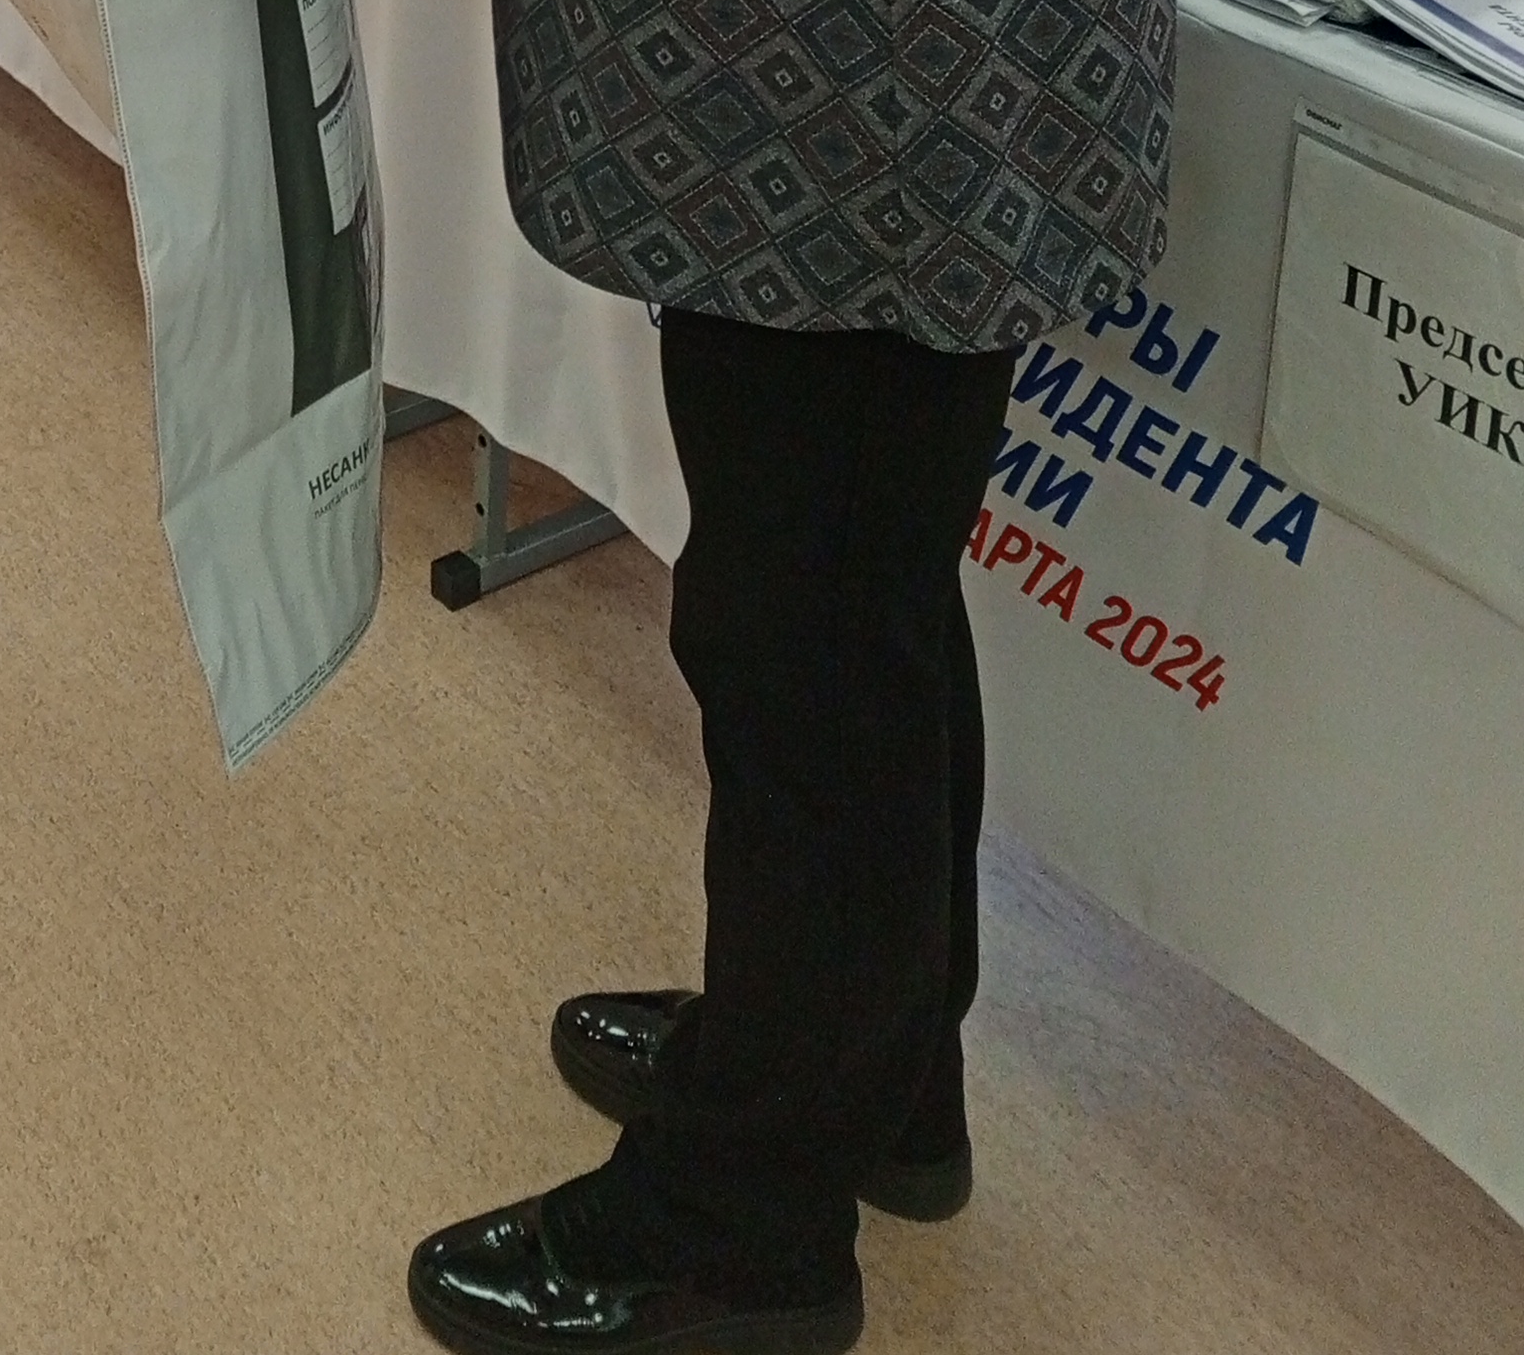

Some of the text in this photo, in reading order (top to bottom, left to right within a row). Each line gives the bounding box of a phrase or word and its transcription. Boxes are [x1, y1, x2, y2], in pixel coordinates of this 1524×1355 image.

[1084, 287, 1221, 393] РЫ
[1340, 260, 1524, 390] Предсе
[1010, 342, 1320, 567] ИДЕНТА
[1393, 357, 1524, 467] УИК
[1084, 595, 1226, 712] 2024
